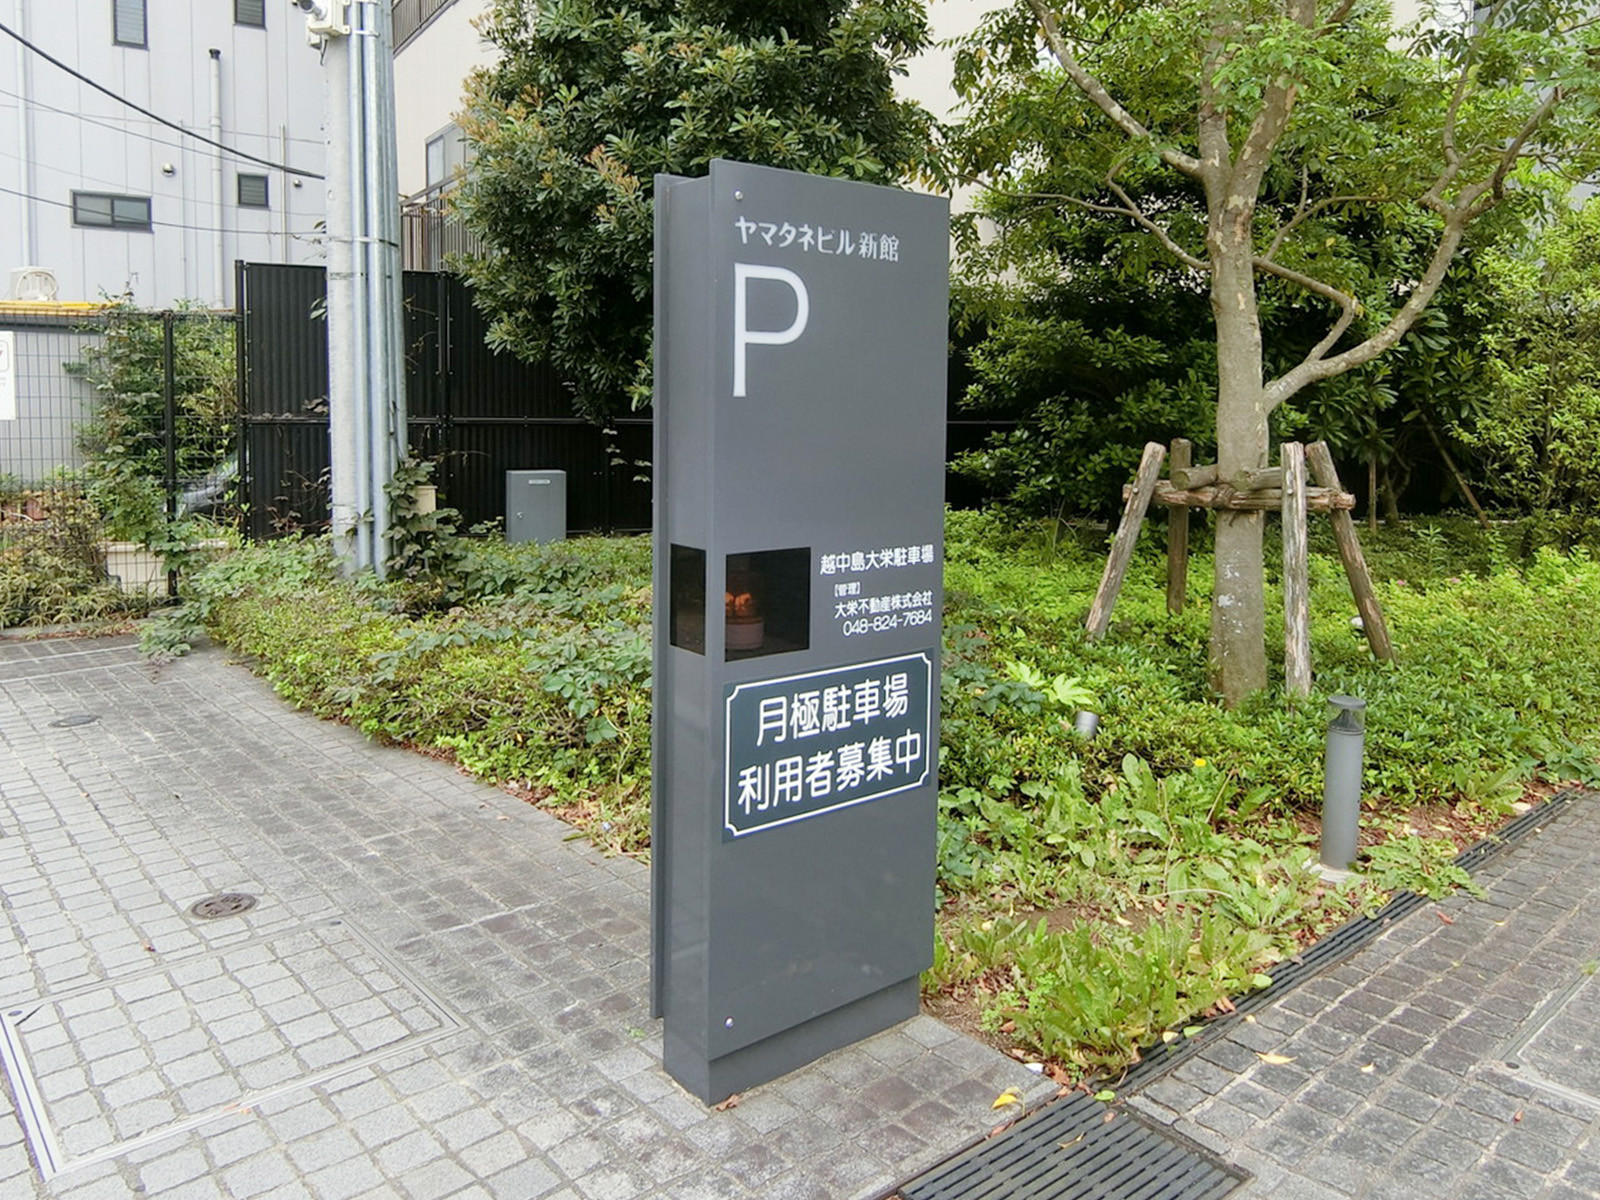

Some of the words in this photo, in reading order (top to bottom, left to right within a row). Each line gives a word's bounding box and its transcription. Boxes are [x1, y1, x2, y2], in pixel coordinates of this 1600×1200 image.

[733, 262, 810, 398] P
[820, 544, 935, 575] 越中島大栄駐車場
[834, 590, 933, 619] 大栄不動産株式会社
[843, 609, 933, 637] 048-824-7684
[756, 672, 909, 747] 月極駐車場
[737, 728, 921, 815] 利用者募集中
